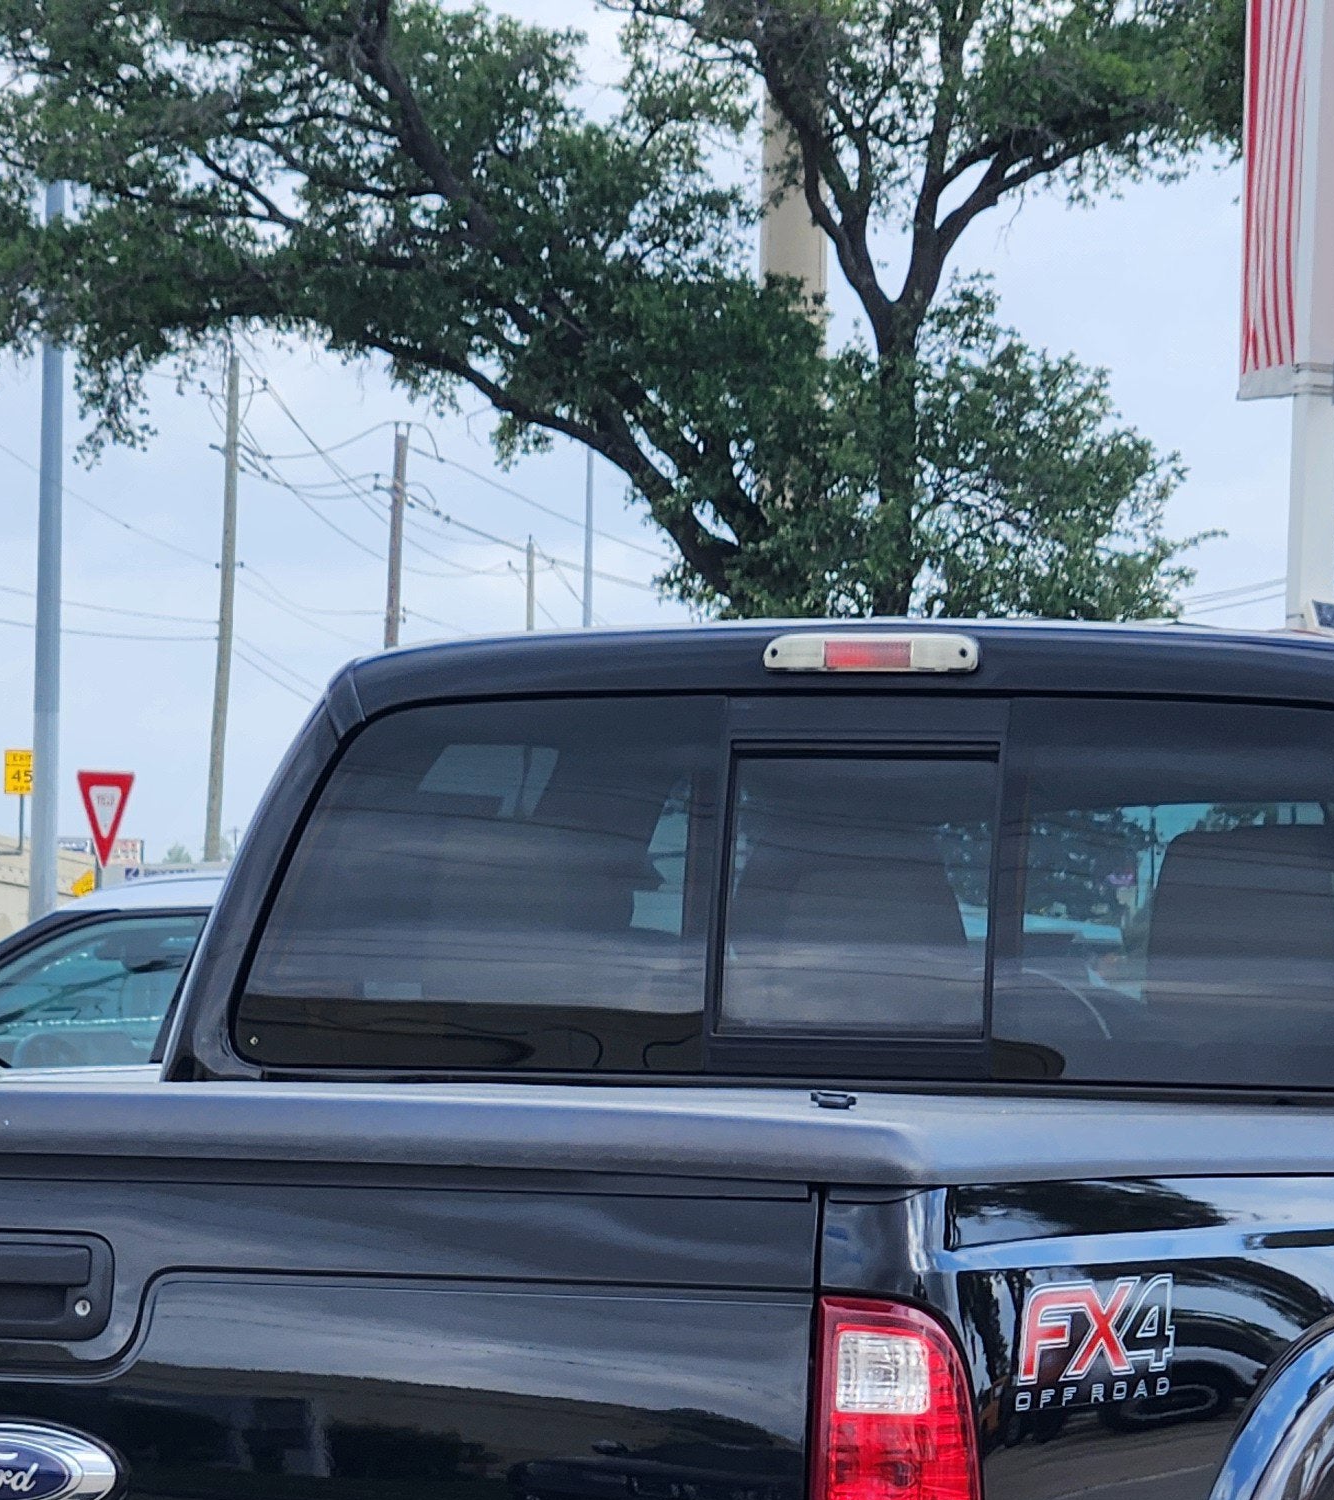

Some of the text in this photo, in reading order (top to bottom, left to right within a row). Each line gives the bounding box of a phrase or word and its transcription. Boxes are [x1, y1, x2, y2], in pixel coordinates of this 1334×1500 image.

[11, 769, 33, 783] 45
[1017, 1273, 1175, 1387] FX4
[1015, 1376, 1170, 1412] OFF ROAD
